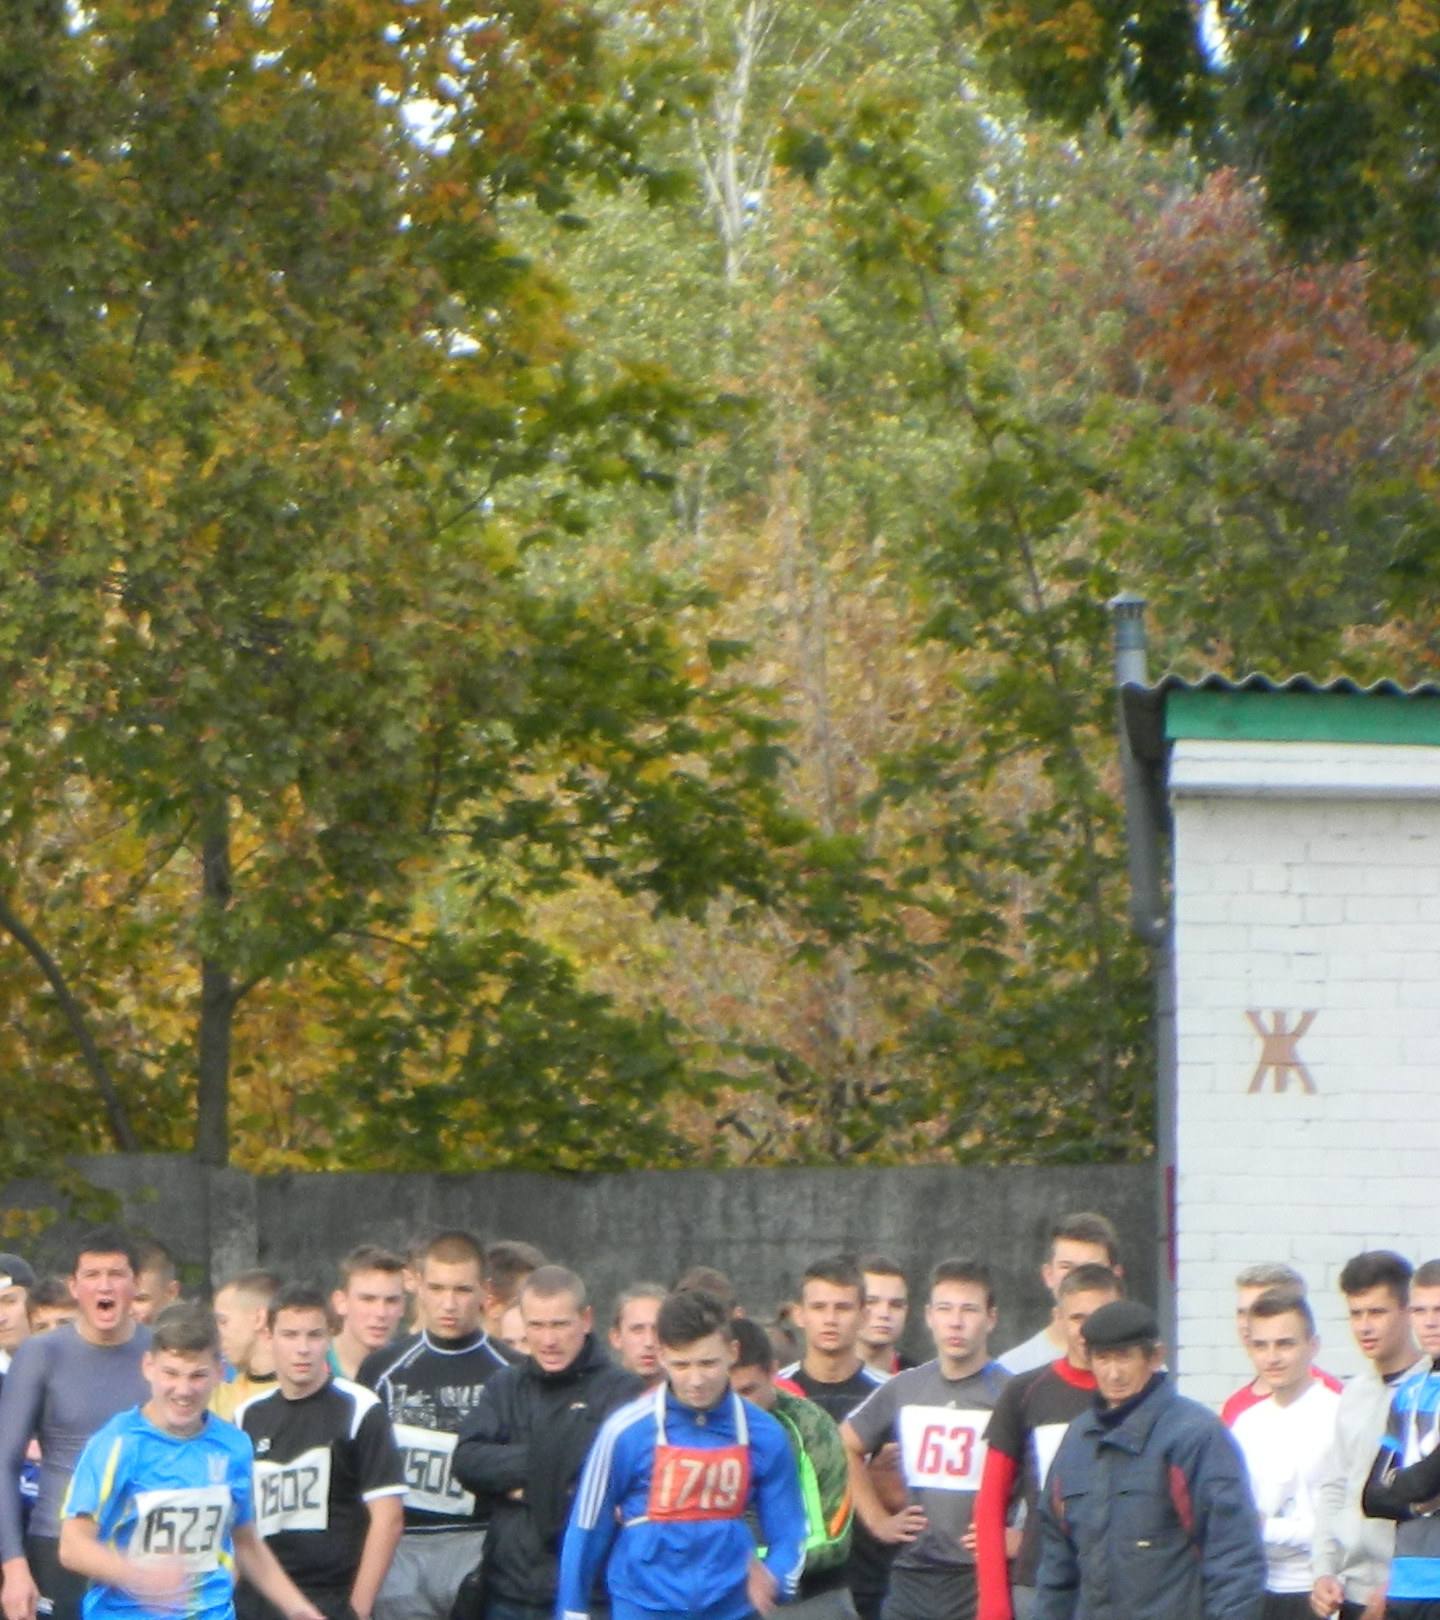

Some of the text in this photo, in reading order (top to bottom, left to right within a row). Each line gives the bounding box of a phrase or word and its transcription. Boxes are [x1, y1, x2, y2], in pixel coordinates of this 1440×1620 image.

[1245, 1010, 1319, 1095] Ж
[916, 1425, 976, 1476] 63
[260, 1466, 321, 1518] 1502
[659, 1458, 742, 1509] 1719
[144, 1505, 223, 1553] 1523
